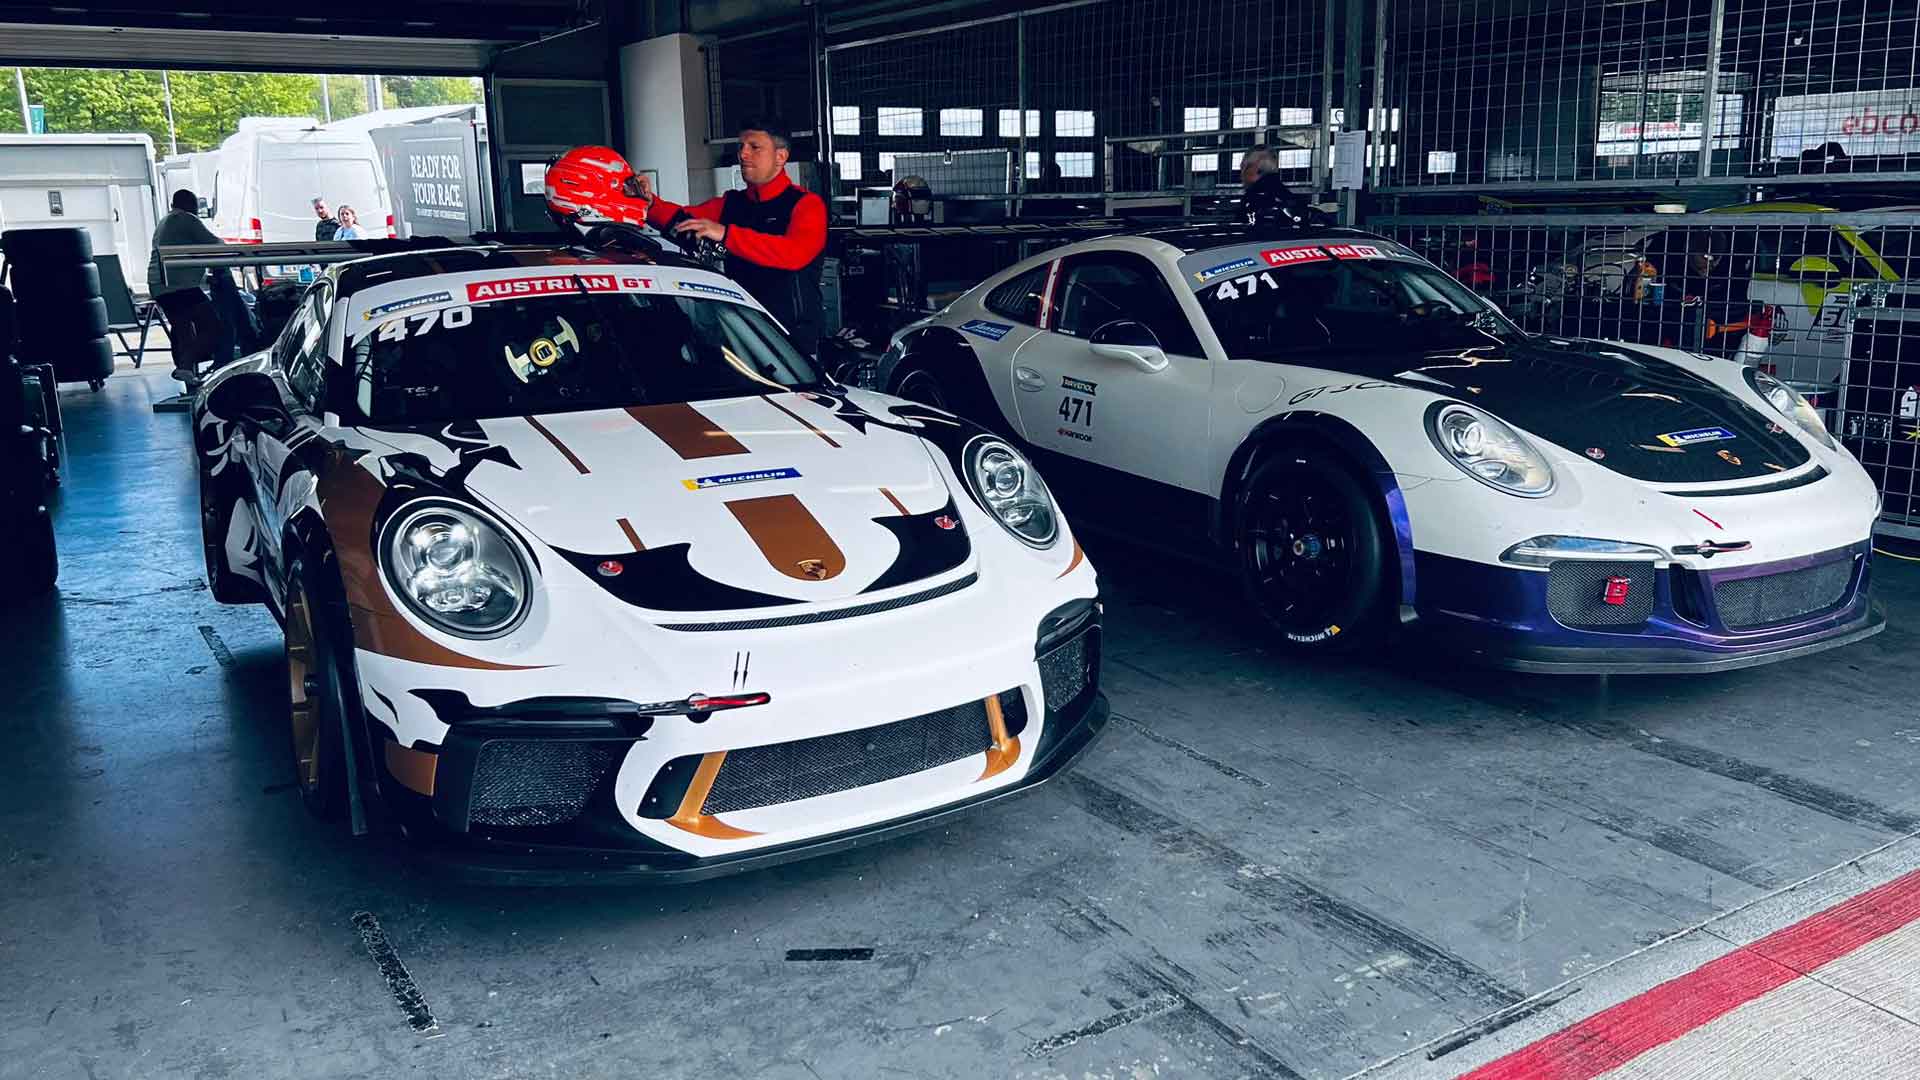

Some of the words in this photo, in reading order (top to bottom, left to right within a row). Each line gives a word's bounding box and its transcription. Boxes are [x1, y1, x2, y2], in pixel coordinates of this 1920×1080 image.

[409, 154, 440, 179] READY
[441, 154, 462, 179] FOR
[412, 182, 437, 206] YOUR
[1269, 245, 1354, 263] AUSTRAN
[1213, 260, 1255, 275] MICHELIN
[622, 278, 653, 289] GT
[1216, 271, 1280, 301] 471
[387, 294, 450, 313] MICHELIN
[378, 305, 473, 343] 470
[1058, 395, 1093, 427] 471
[1683, 431, 1723, 441] MICHELIN
[719, 472, 786, 483] MICHELIN
